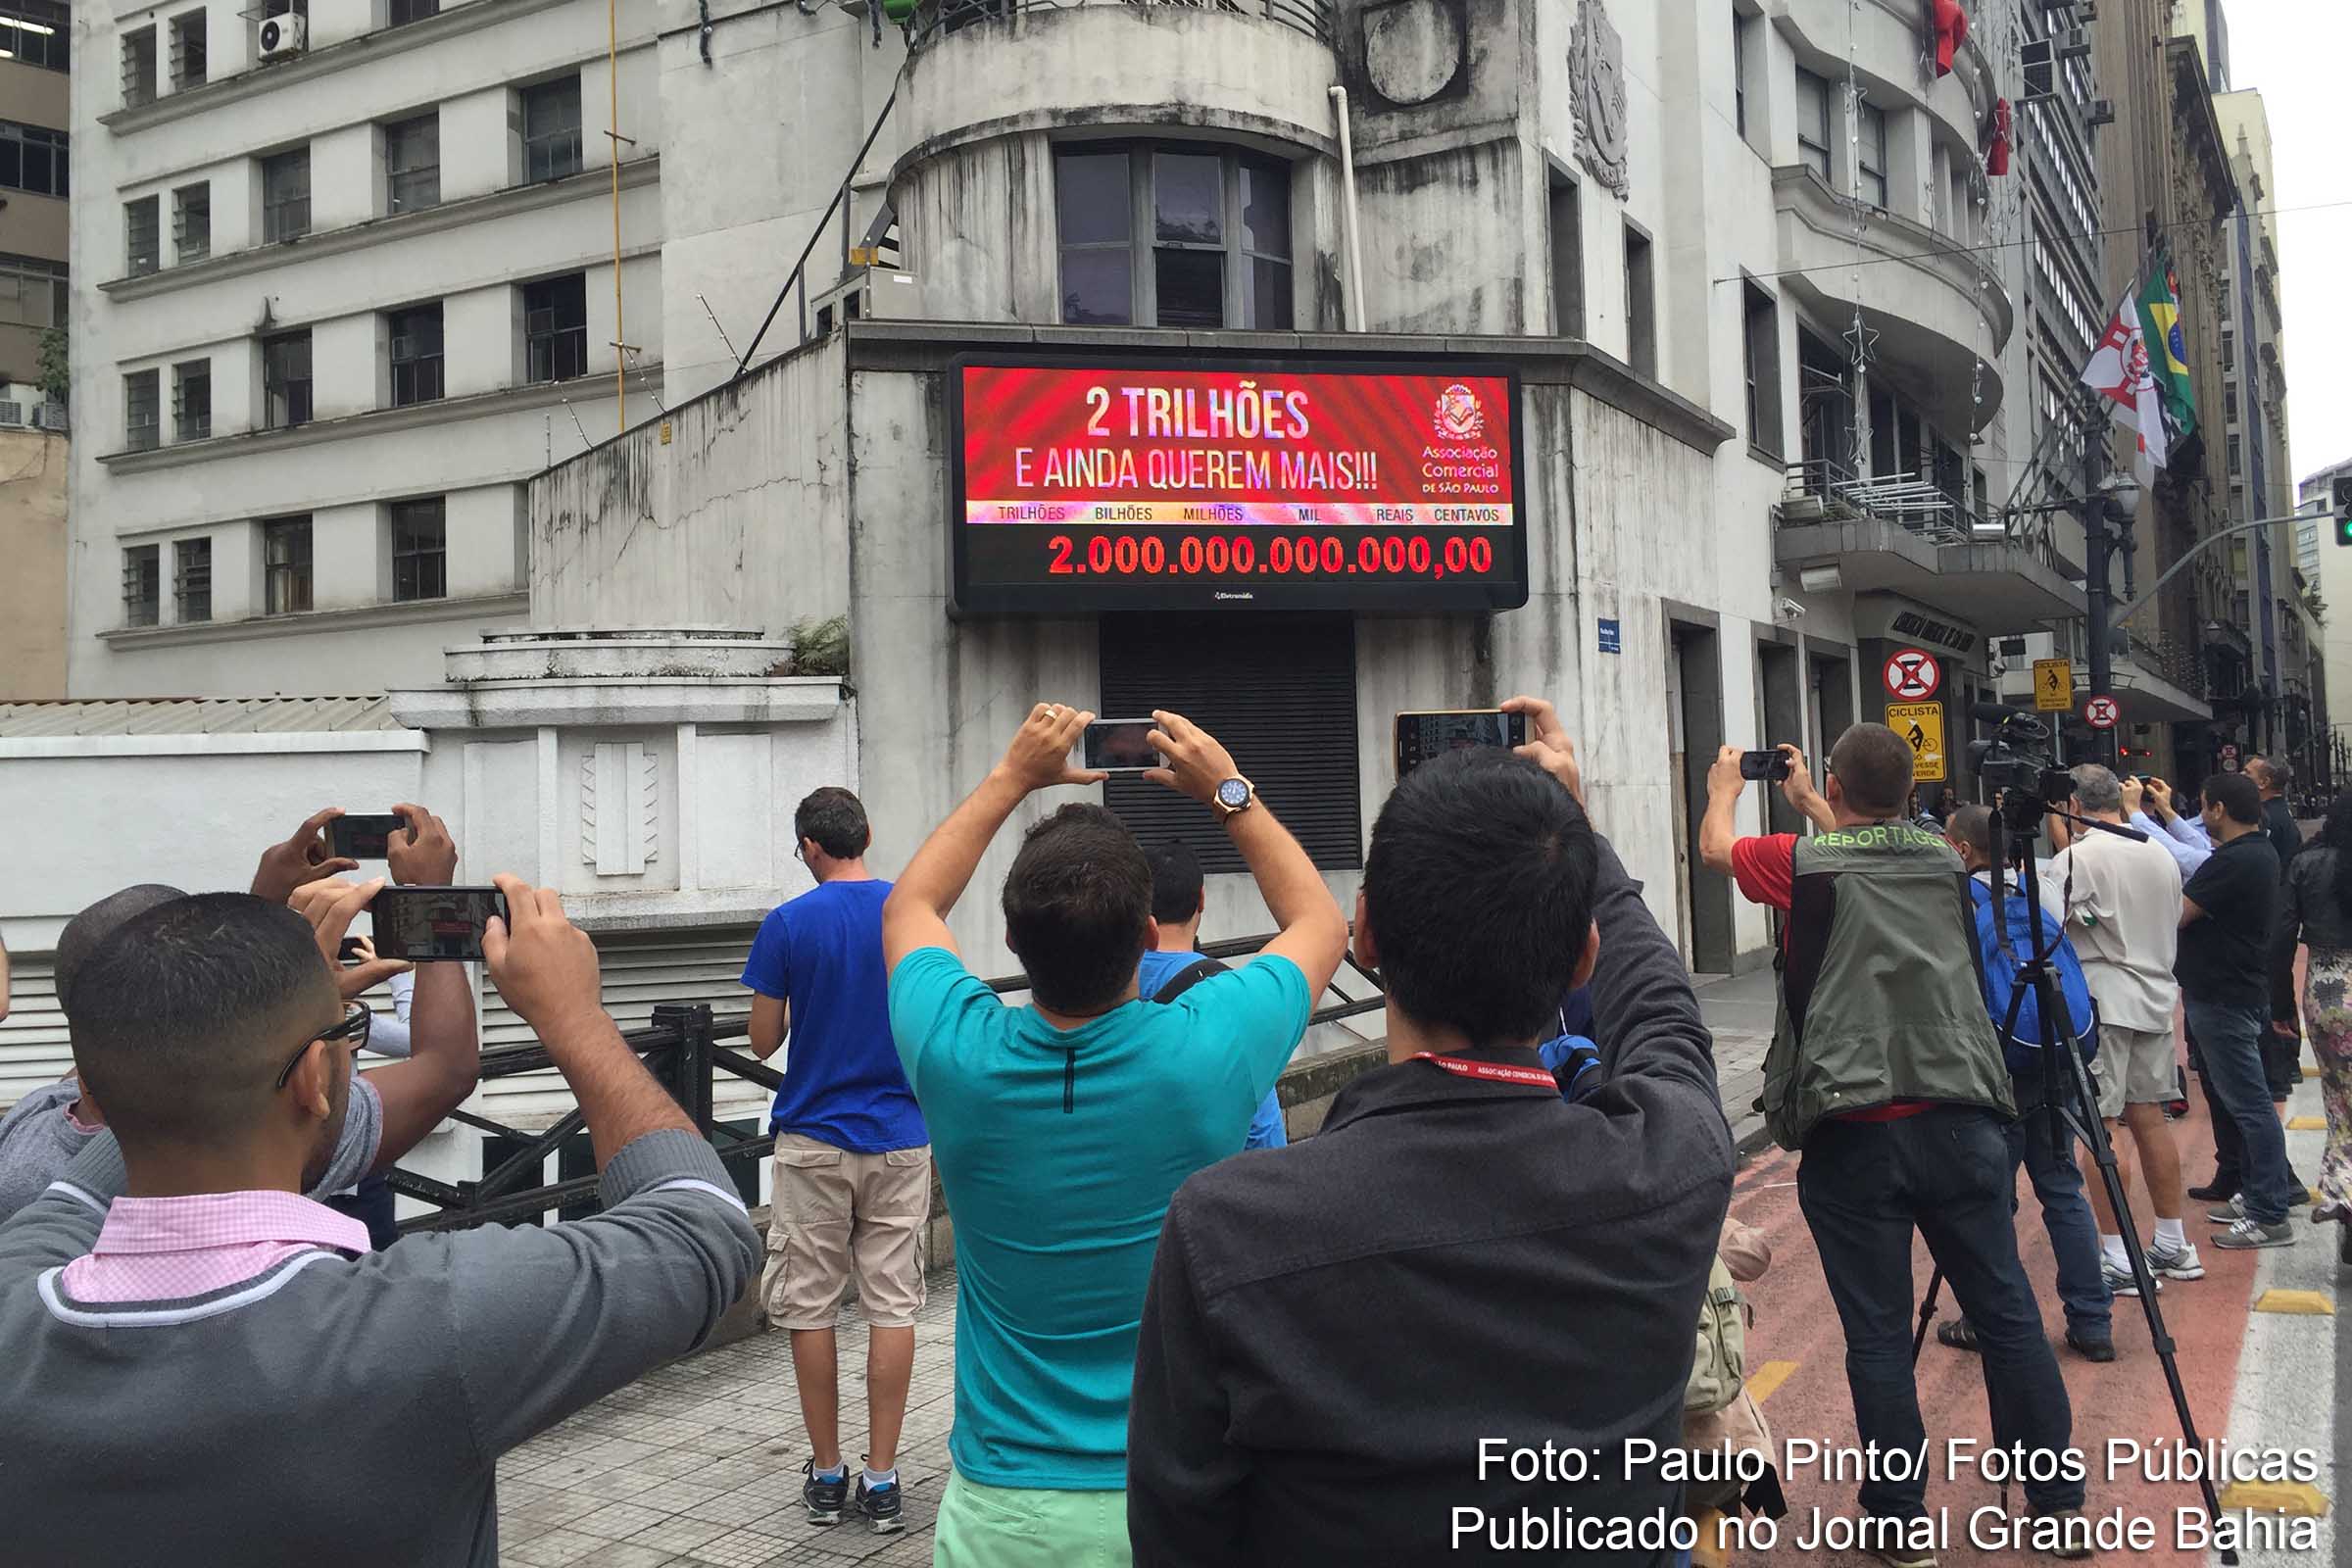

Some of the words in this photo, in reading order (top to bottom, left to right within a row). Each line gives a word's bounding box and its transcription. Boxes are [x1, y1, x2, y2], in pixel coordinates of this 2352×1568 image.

[1086, 386, 1110, 436] 2
[1121, 380, 1309, 439] TRILHÕES
[1422, 446, 1497, 461] Associação
[1015, 448, 1034, 487] E
[1044, 448, 1139, 488] AINDA
[1148, 449, 1270, 490] QUEREM
[1281, 452, 1378, 490] MAIS!!!
[1422, 463, 1498, 478] Comercial
[1422, 484, 1436, 493] DE
[1439, 481, 1461, 493] SÃO
[1463, 484, 1498, 493] PAULO
[998, 505, 1065, 519] TRILHÕES
[1095, 506, 1152, 520] BILHÕES
[1183, 506, 1244, 521] MILHÕES
[1298, 510, 1321, 521] MIL
[1376, 510, 1414, 521] REAIS
[1434, 509, 1499, 522] CENTAVOS
[1048, 535, 1493, 580] 2.000.000.000.000,00
[1888, 707, 1938, 717] CICLISTA
